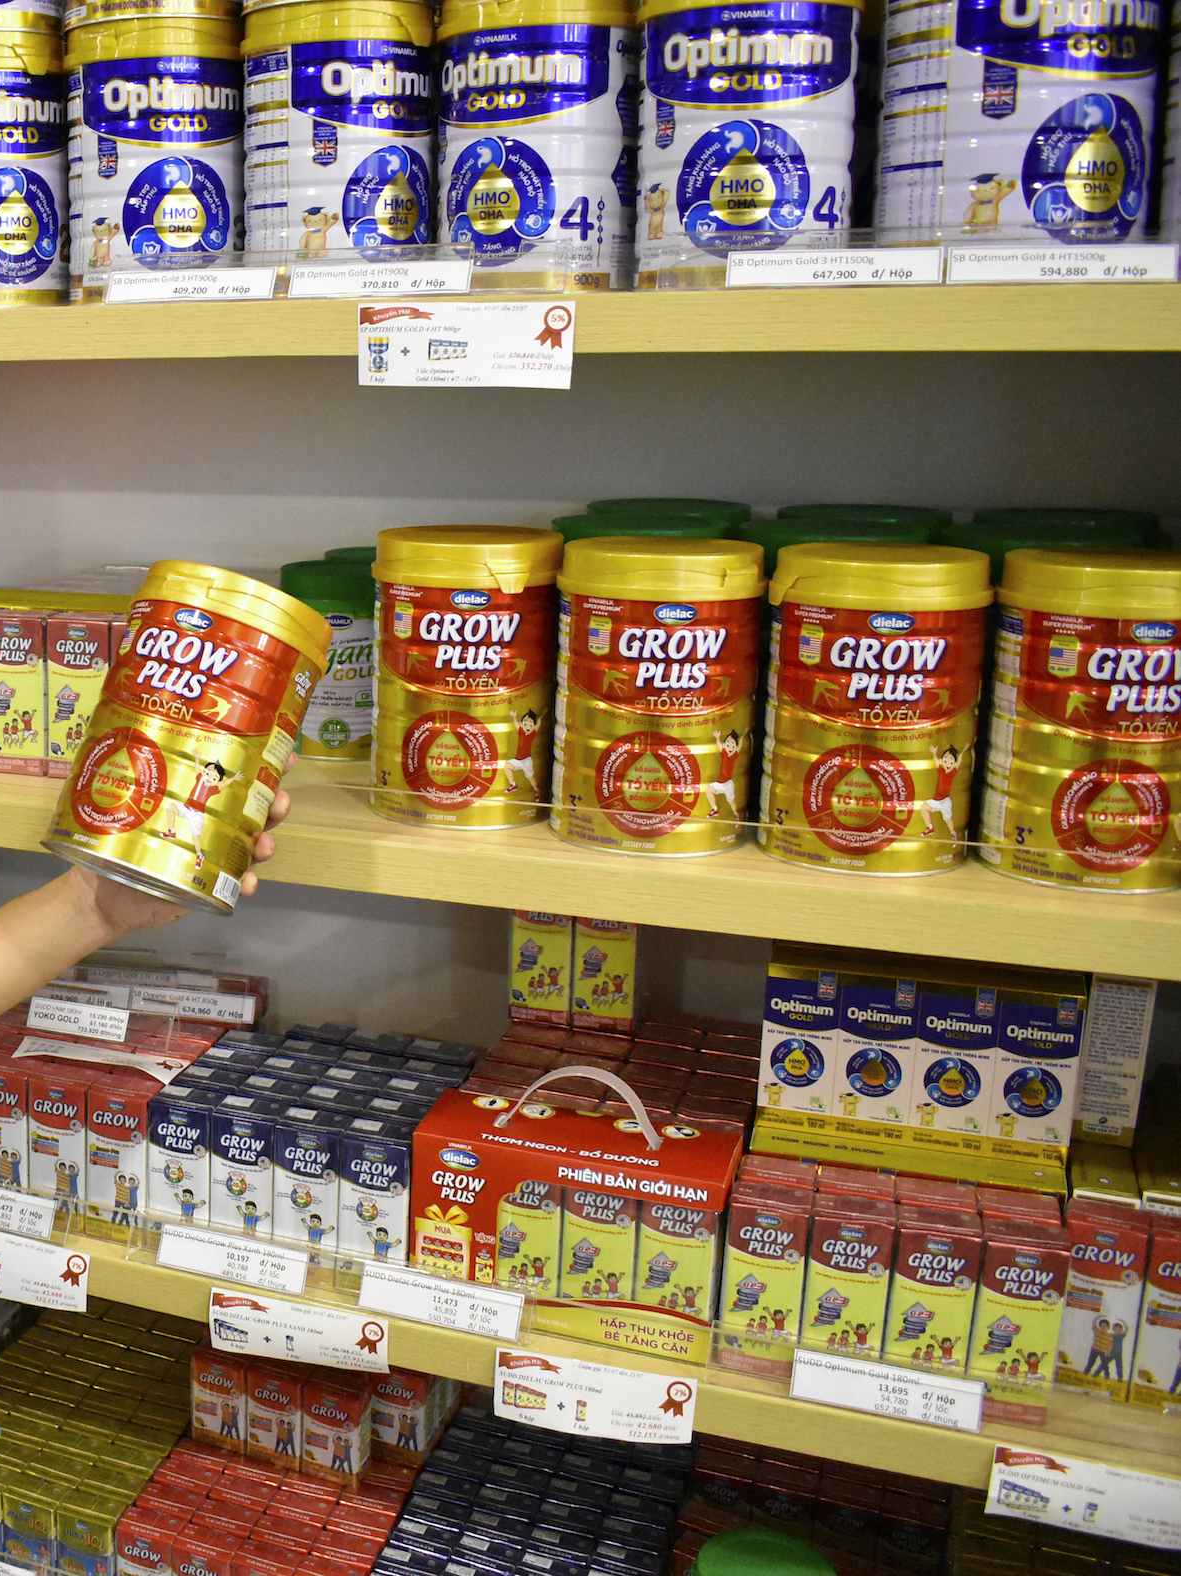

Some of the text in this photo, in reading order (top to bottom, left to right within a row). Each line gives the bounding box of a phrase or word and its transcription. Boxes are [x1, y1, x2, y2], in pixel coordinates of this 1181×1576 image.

[731, 10, 774, 20] VINAMILK
[480, 33, 517, 44] VINAMILK
[1066, 33, 1135, 59] GOLD
[389, 46, 417, 55] VINAMILK
[663, 26, 833, 77] Optimum
[166, 61, 200, 70] VINAMILK
[321, 61, 431, 104] Optimu
[442, 51, 581, 99] Optimum
[708, 71, 782, 92] GOLD
[103, 77, 240, 119] Optimum
[466, 90, 527, 112] GOLD
[149, 114, 209, 133] GOLD
[704, 157, 716, 173] THU
[1077, 160, 1118, 177] HMO
[720, 178, 764, 194] HMO
[1083, 182, 1111, 194] DHA
[474, 192, 510, 207] HMO
[727, 198, 757, 210] DHA
[162, 207, 198, 220] HMO
[560, 196, 595, 241] 4
[732, 255, 874, 268] SB Optimum Gold 3 HT1500g
[953, 252, 1106, 264] SB Optimum Gold 4 HT1500g
[295, 267, 409, 280] SB Optimum Gold 4 HT900g
[573, 274, 600, 288] 900g
[812, 269, 857, 280] 647,900
[889, 267, 913, 281] Hộp
[1040, 266, 1088, 277] 594,880
[1122, 266, 1147, 278] Hộp
[361, 281, 399, 290] 370,810
[425, 278, 446, 291] Hộp
[373, 310, 398, 322] Khuyến
[551, 314, 566, 323] 5%
[443, 326, 462, 334] 900gr
[520, 362, 553, 371] 352.270
[455, 594, 488, 606] dielac
[177, 610, 209, 629] dielac
[658, 607, 695, 620] dielac
[873, 616, 911, 629] dielac
[419, 612, 520, 643] GROW
[1135, 625, 1174, 639] dielac
[135, 627, 240, 677] GROW
[618, 627, 727, 661] GROW
[434, 645, 502, 671] PLUS
[829, 637, 947, 672] GROW
[136, 660, 207, 700] PLUS
[445, 673, 500, 691] TỔ YẾN
[635, 661, 708, 689] PLUS
[846, 672, 924, 702] PLUS
[141, 690, 194, 722] TỔ YẾN
[646, 691, 705, 711] TỔ YẾN
[859, 702, 920, 724] TỔ YẾN
[182, 1006, 211, 1016] 674,960
[770, 997, 834, 1018] Optimum
[33, 1011, 80, 1024] YOKO GOLD
[925, 1015, 993, 1037] Optimum
[157, 1122, 200, 1141] GROW
[165, 1136, 194, 1151] PLUS
[481, 1132, 660, 1167] THƠM NGON BỔ DƯỠNG
[443, 1153, 476, 1167] dielac
[431, 1170, 485, 1192] GROW
[558, 1166, 709, 1203] PHIÊN BẢN GIỚI HẠN
[440, 1187, 475, 1204] PLUS
[434, 1224, 453, 1236] MUA
[474, 1232, 496, 1246] TẶNG
[739, 1225, 794, 1248] GROW
[226, 1252, 250, 1264] 10,197
[747, 1240, 784, 1259] PLUS
[994, 1264, 1054, 1287] GROW
[1004, 1280, 1043, 1298] PLUS
[599, 1315, 695, 1344] HẤP THU KHỎE
[603, 1328, 689, 1355] BÉ TĂNG CÂN
[797, 1356, 822, 1368] SUDD
[824, 1361, 866, 1376] Optimum
[868, 1369, 889, 1380] Gold
[199, 1371, 235, 1389] GROW
[674, 1388, 687, 1397] 7%
[878, 1384, 909, 1396] 13,695
[936, 1393, 956, 1406] Hộp
[874, 1403, 908, 1416] 657,360
[124, 1544, 162, 1563] GROW
